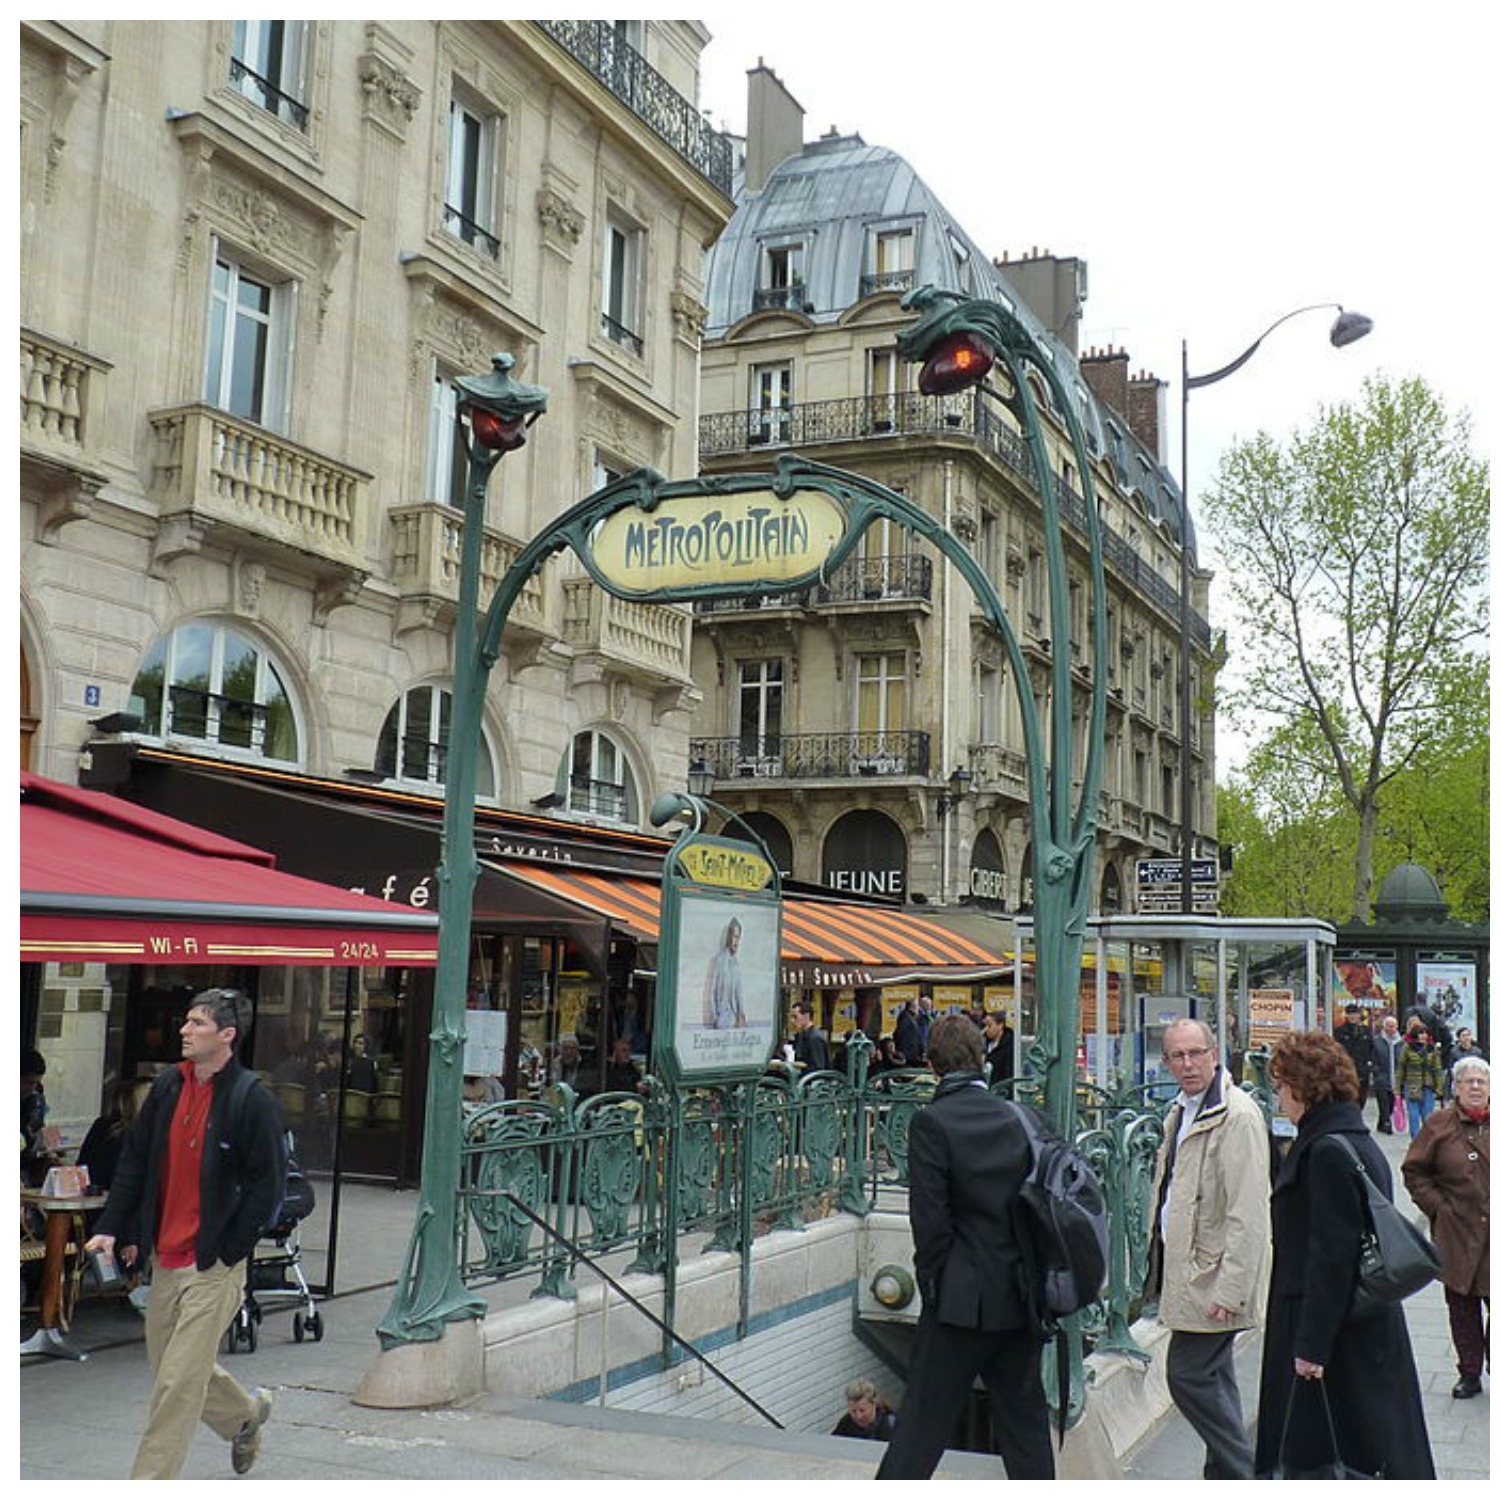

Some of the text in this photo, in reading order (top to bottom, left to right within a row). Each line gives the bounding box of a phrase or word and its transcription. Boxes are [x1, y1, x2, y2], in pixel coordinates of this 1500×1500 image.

[625, 506, 808, 571] METROPOLITAIN
[492, 837, 572, 862] Severin
[830, 871, 901, 892] JEUNE
[341, 942, 379, 958] 24/24
[814, 967, 873, 985] Severin
[1251, 1002, 1292, 1013] CHOPIN
